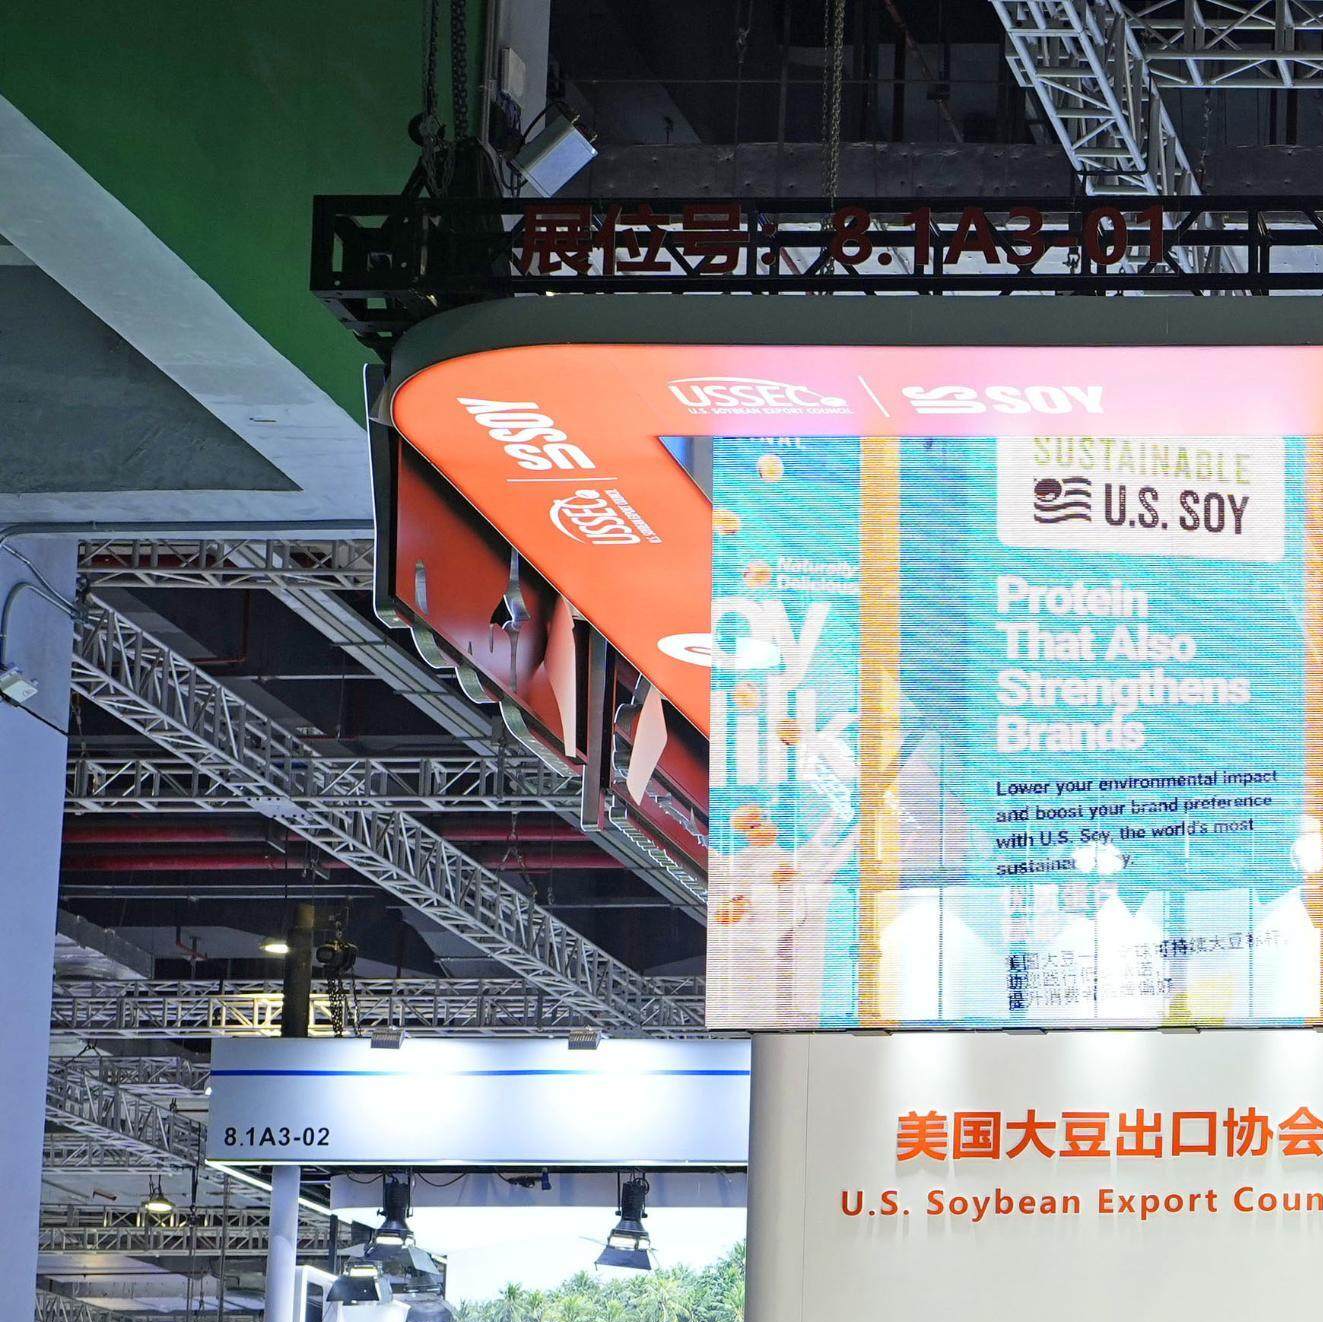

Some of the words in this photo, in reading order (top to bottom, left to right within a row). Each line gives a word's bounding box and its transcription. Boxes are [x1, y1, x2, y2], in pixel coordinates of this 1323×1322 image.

[667, 385, 818, 407] USSEC
[987, 385, 1104, 414] SOY
[1032, 436, 1251, 485] SUSTAINABLE
[1103, 482, 1169, 530] U.S.
[1179, 489, 1250, 535] SOY
[996, 575, 1149, 618] Protein
[996, 622, 1096, 661] That
[1104, 624, 1197, 662] Also
[996, 667, 1252, 720] Strengthens
[996, 714, 1147, 753] Brands
[996, 780, 1050, 796] Lower
[1055, 780, 1093, 797] your
[1099, 770, 1218, 792] environmental
[1222, 770, 1278, 787] impact
[996, 806, 1029, 823] and
[1035, 805, 1084, 821] boost
[1089, 805, 1126, 822] your
[1130, 797, 1179, 815] brand
[1183, 795, 1273, 814] preference
[996, 832, 1034, 849] with
[1039, 830, 1074, 846] U.S.
[1079, 829, 1115, 846] Soy,
[1120, 825, 1147, 840] the
[1150, 822, 1209, 838] world's
[1213, 818, 1255, 834] most
[223, 1127, 331, 1148] 8.1A3-02
[839, 1189, 911, 1217] U.S.
[926, 1188, 1082, 1222] Soybean
[1098, 1188, 1219, 1221] Export
